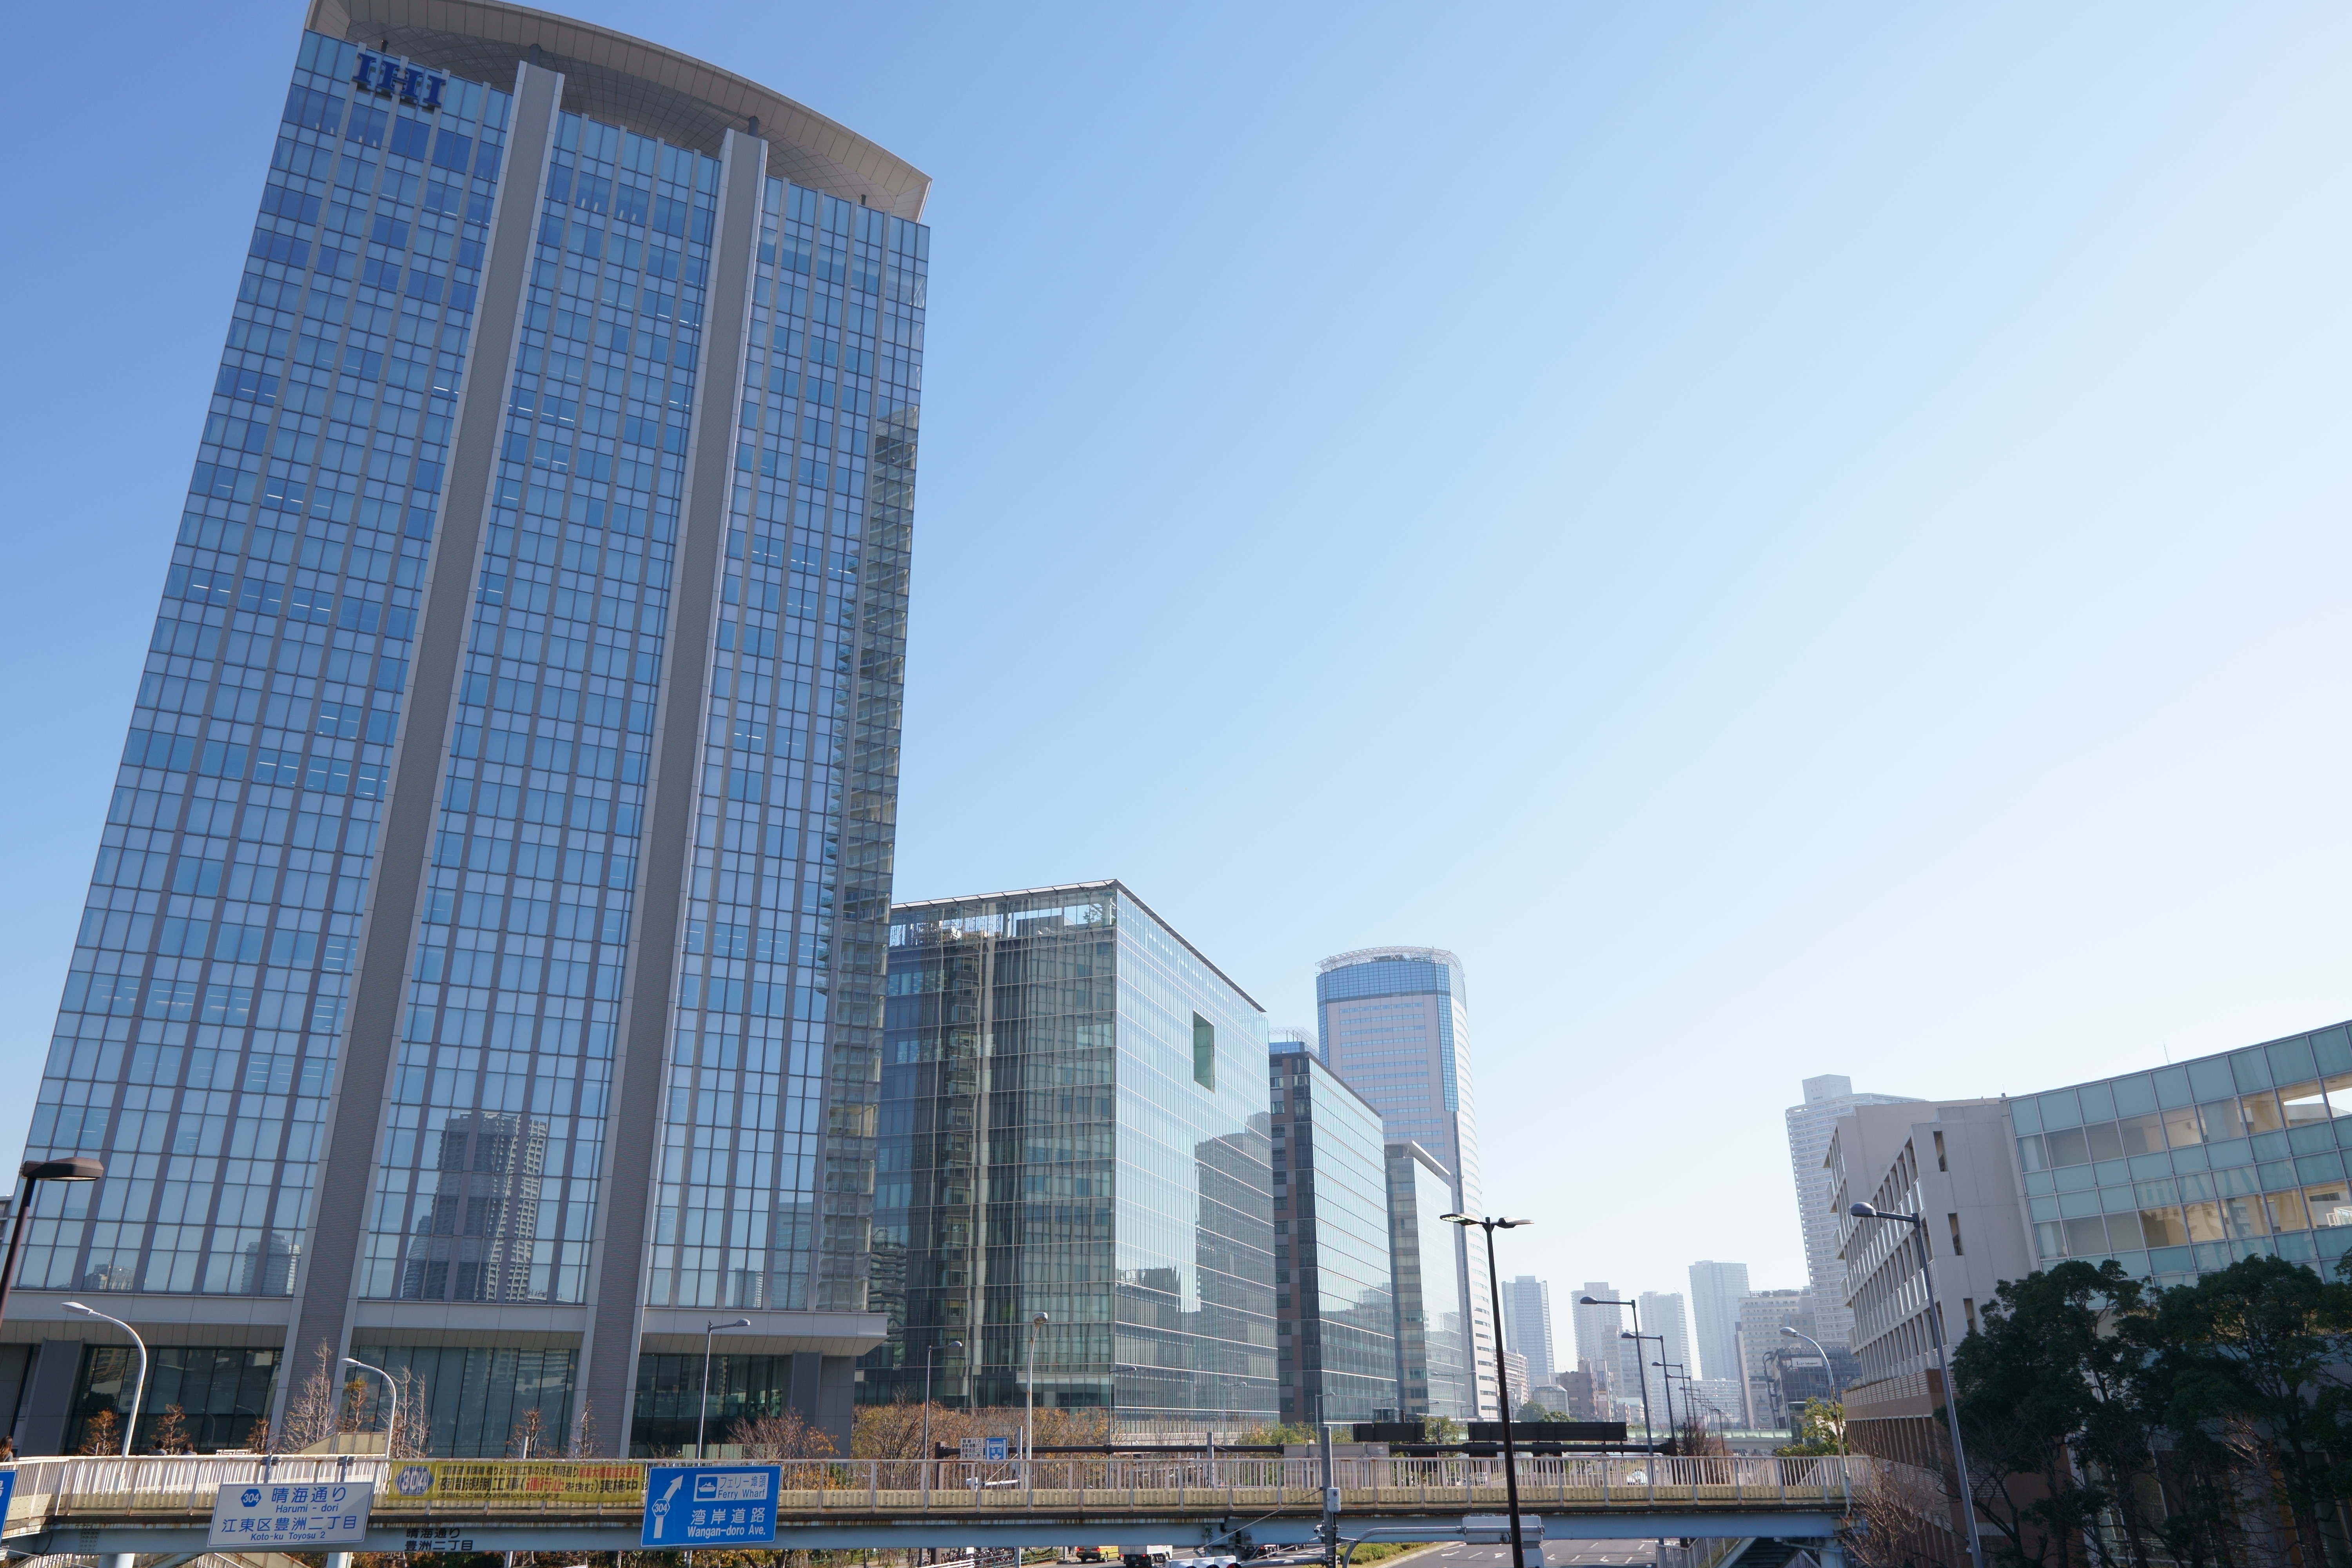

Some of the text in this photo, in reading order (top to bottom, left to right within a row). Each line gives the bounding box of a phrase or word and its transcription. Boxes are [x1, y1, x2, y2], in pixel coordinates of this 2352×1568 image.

[352, 53, 446, 107] IHI
[401, 1470, 428, 1490] 304
[720, 1475, 766, 1489] フェリー埠頭
[243, 1493, 260, 1503] 304
[271, 1487, 346, 1503] 晴海通り
[718, 1489, 765, 1500] Ferry Wharf
[276, 1504, 308, 1513] Harumi
[321, 1503, 339, 1512] dori
[654, 1503, 668, 1512] 304
[691, 1507, 766, 1525] 湾岸道路
[221, 1516, 357, 1533] 江東区豊洲二丁目
[289, 1532, 316, 1541] Toyosu
[406, 1528, 460, 1539] 晴海通り
[688, 1524, 766, 1539] Wangan-doro Ave.
[405, 1540, 473, 1551] 豊洲二丁目
